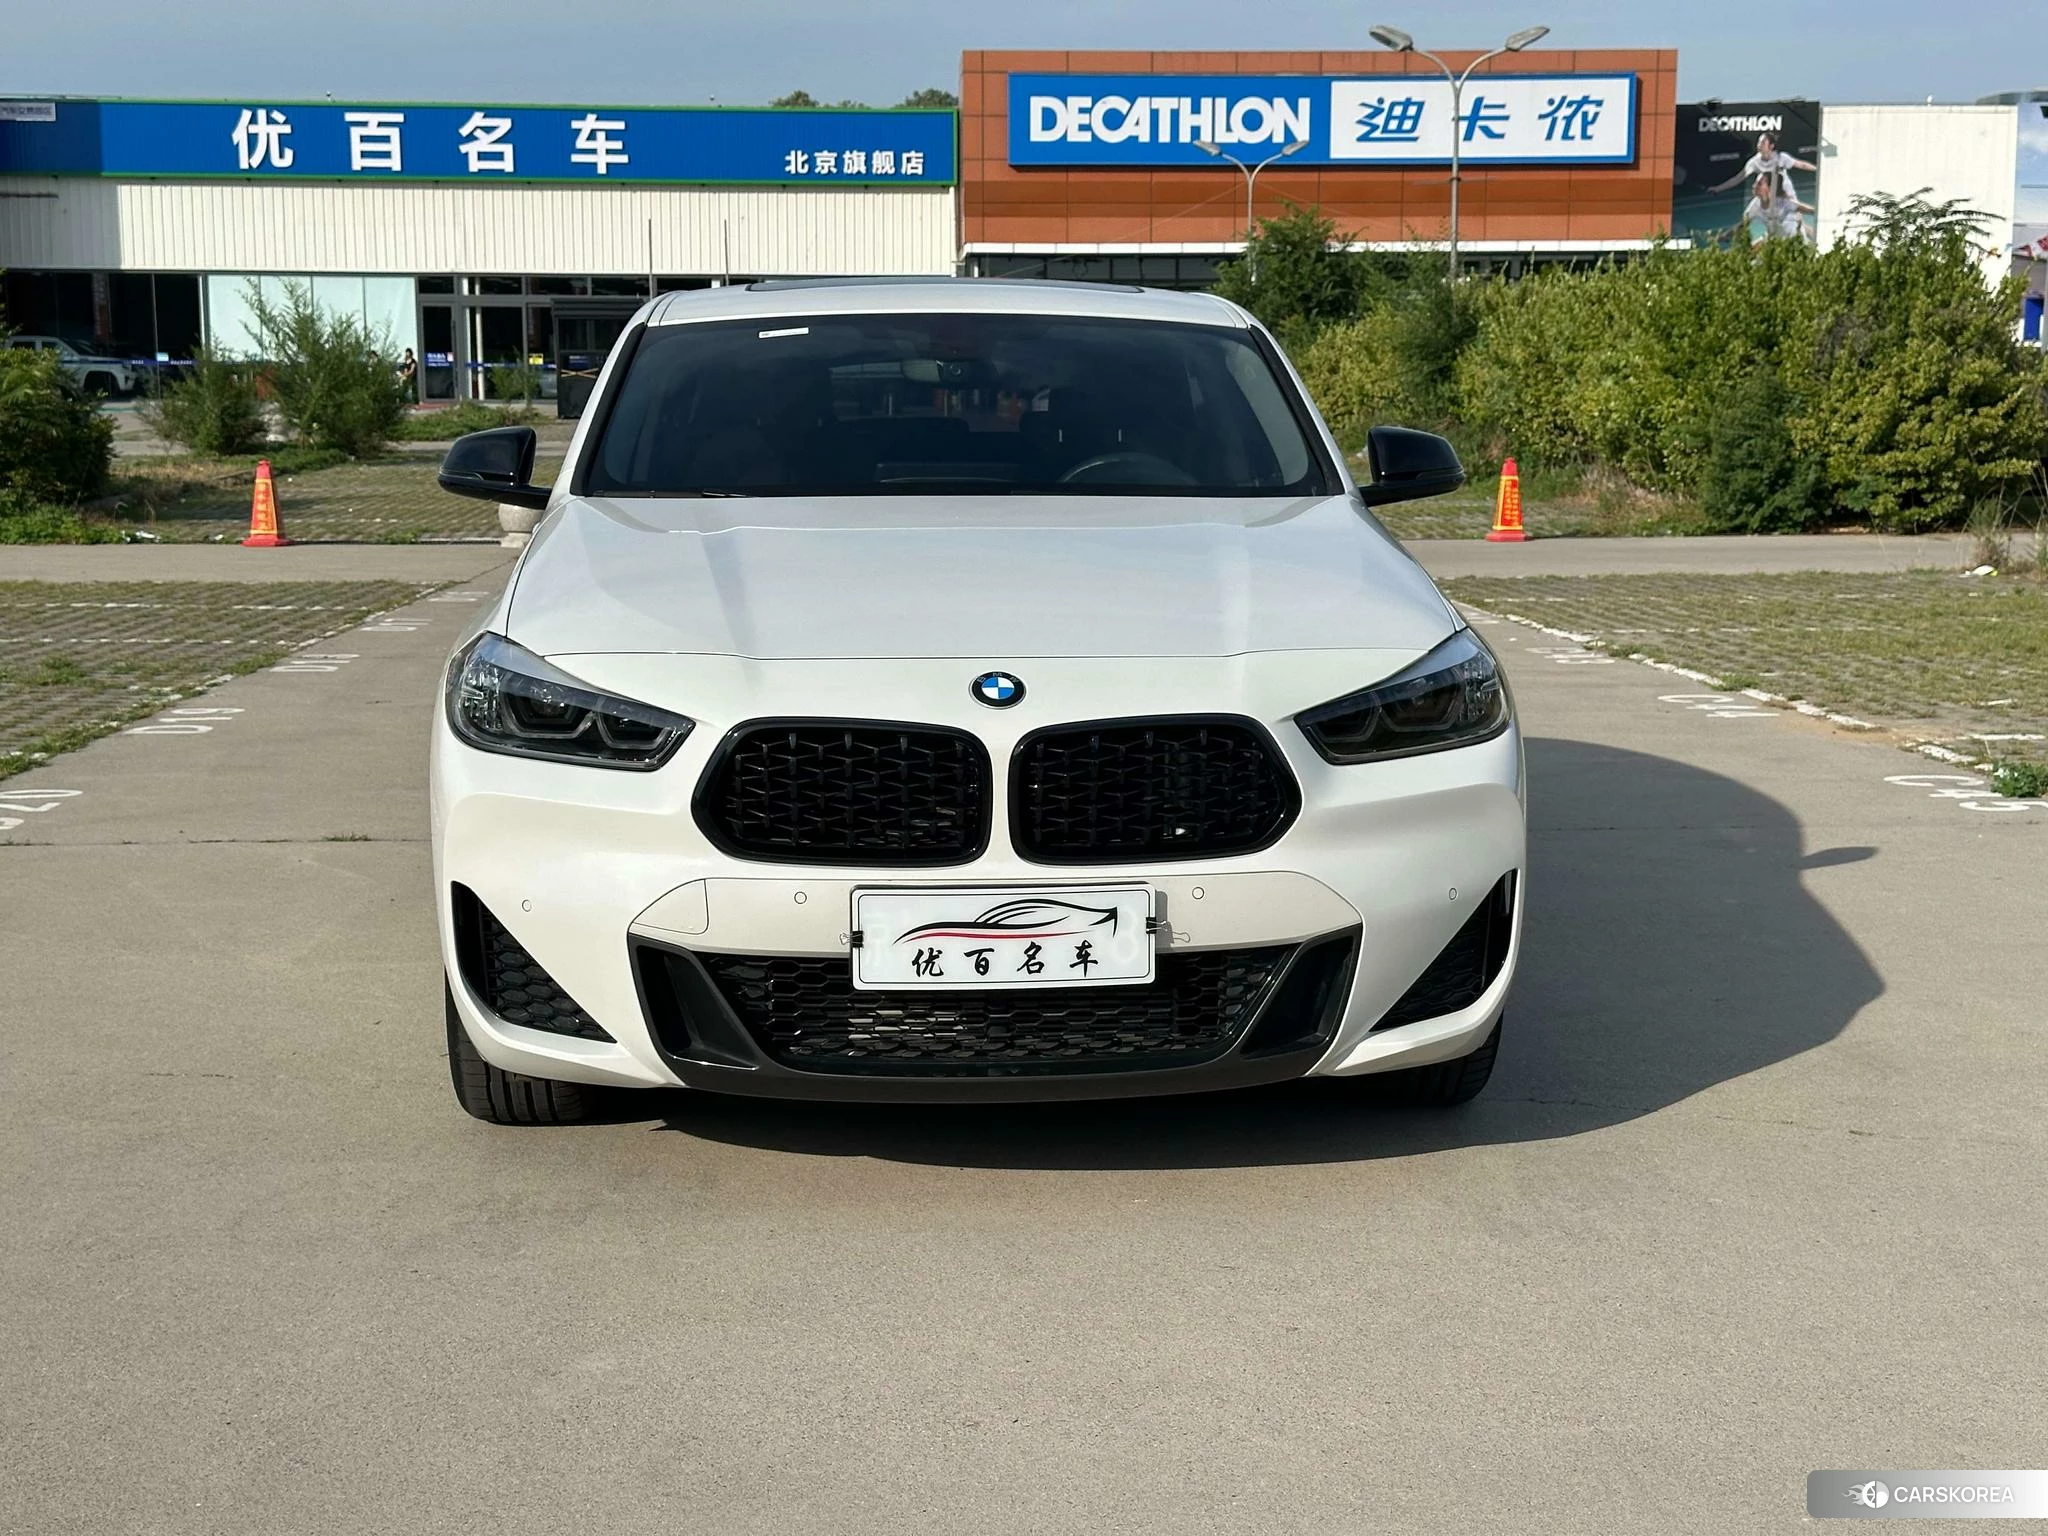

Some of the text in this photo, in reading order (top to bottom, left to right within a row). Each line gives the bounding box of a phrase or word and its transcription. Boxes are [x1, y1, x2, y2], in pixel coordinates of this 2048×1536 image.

[1029, 95, 1311, 143] DECATHLON
[1356, 95, 1604, 142] 迪卡侬
[1698, 115, 1782, 132] DECATHLON
[231, 107, 630, 175] 优百名车
[784, 150, 924, 175] 北京旗舰店
[911, 939, 1099, 977] 优百名车
